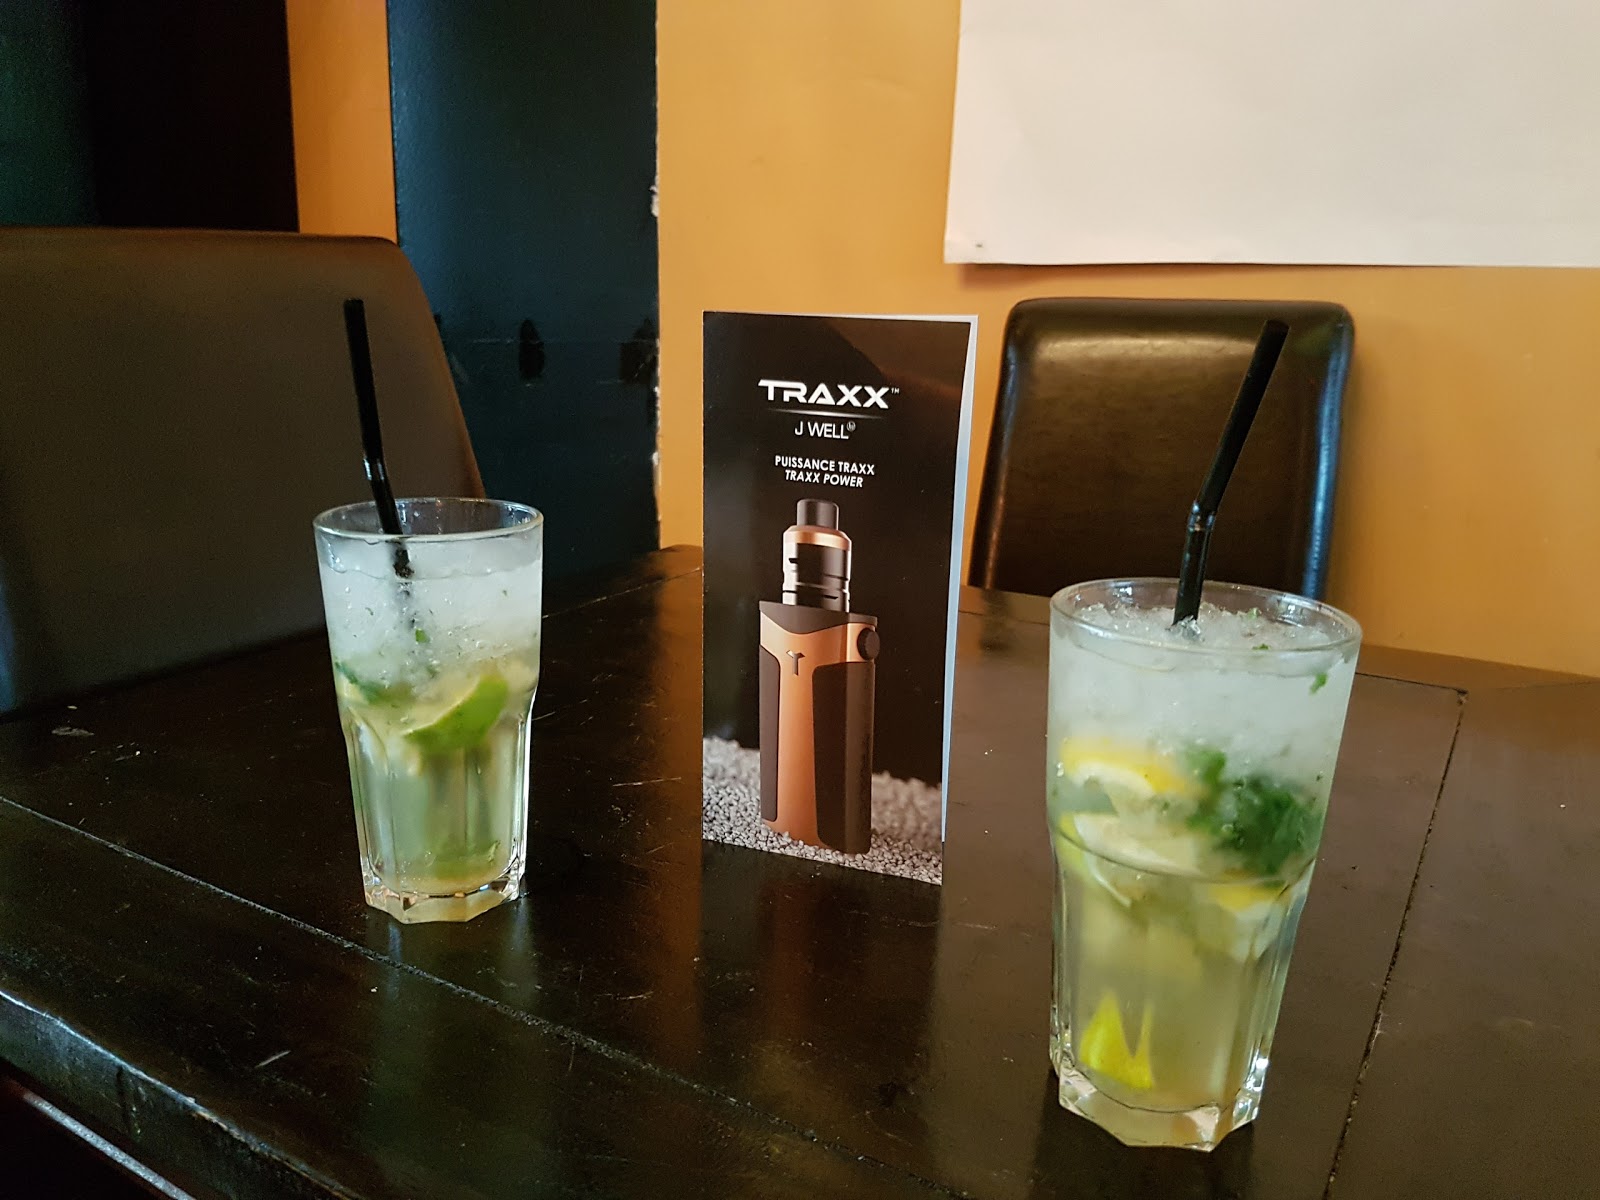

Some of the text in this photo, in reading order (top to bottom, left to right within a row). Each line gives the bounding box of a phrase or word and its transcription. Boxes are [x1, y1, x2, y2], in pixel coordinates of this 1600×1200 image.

[758, 379, 889, 409] TRAXX
[794, 421, 849, 440] J WELL
[774, 455, 875, 475] PUISSANCE TRAXX
[785, 469, 864, 488] TRAXX POWER
